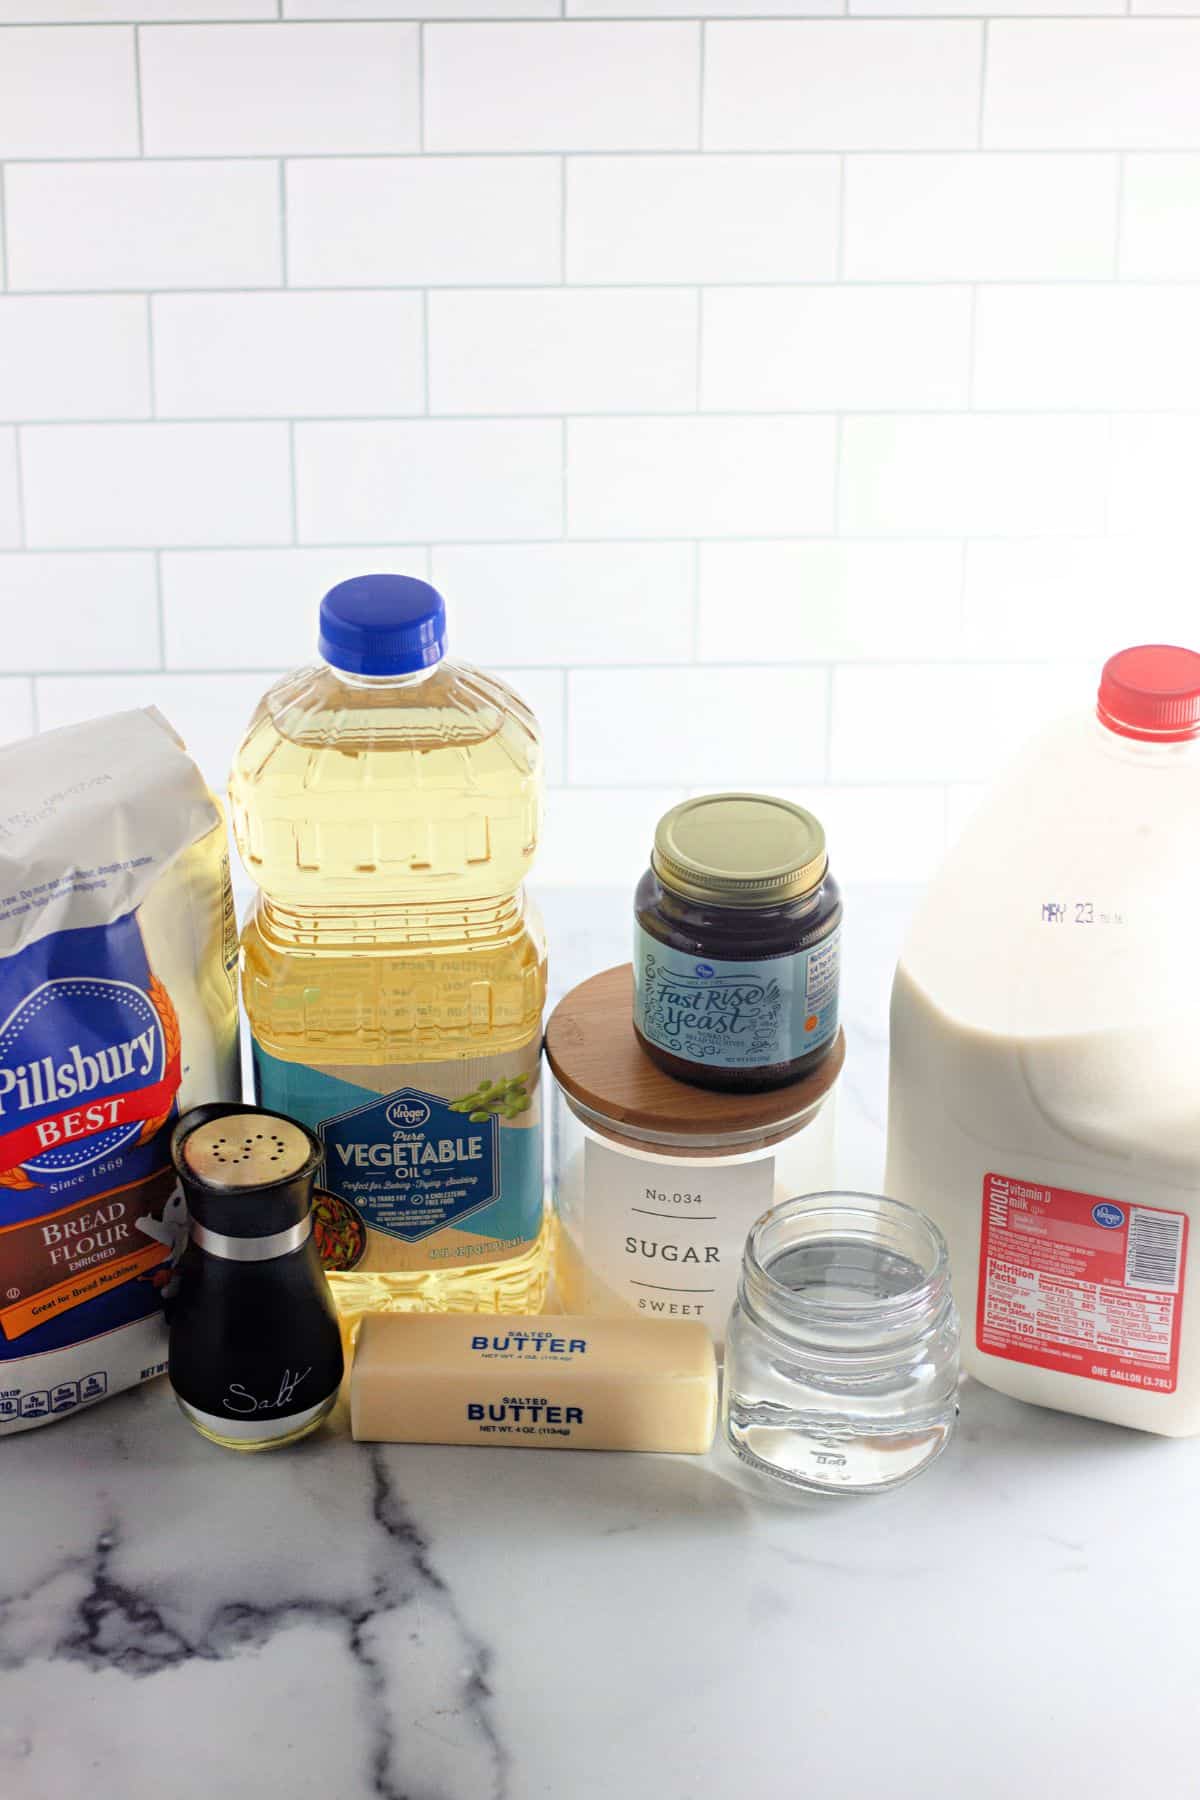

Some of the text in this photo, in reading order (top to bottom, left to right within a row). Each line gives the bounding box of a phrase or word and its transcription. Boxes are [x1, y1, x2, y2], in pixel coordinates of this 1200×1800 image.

[1074, 901, 1094, 923] 23
[657, 983, 760, 1010] Fast Rise
[664, 1007, 756, 1036] Yeast
[0, 1025, 156, 1116] Pillsbury
[35, 1098, 126, 1148] BEST
[393, 1103, 425, 1124] Kroger
[336, 1136, 483, 1167] VEGETABLE
[50, 1158, 124, 1194] Since 1869
[394, 1167, 420, 1179] OIL
[645, 1188, 703, 1204] No.034
[988, 1177, 1009, 1228] WHOLE
[1009, 1184, 1052, 1203] vitamin D
[1009, 1197, 1028, 1210] milk
[41, 1202, 126, 1247] BREAD
[50, 1222, 130, 1266] FLOUR
[625, 1236, 721, 1263] SUGAR
[69, 1248, 116, 1272] ENRICHED
[989, 1259, 1034, 1280] Nutrition
[989, 1270, 1017, 1285] Facts
[32, 1299, 56, 1316] Great
[72, 1280, 98, 1298] Bread
[639, 1298, 705, 1316] SWEET
[1018, 1322, 1034, 1335] 150
[471, 1336, 587, 1353] BUTTER
[1091, 1365, 1109, 1377] ONE
[1110, 1368, 1142, 1383] GALLON
[222, 1366, 313, 1413] Salt
[502, 1396, 548, 1405] SALTED
[467, 1403, 584, 1424] BUTTER
[480, 1425, 497, 1433] NET
